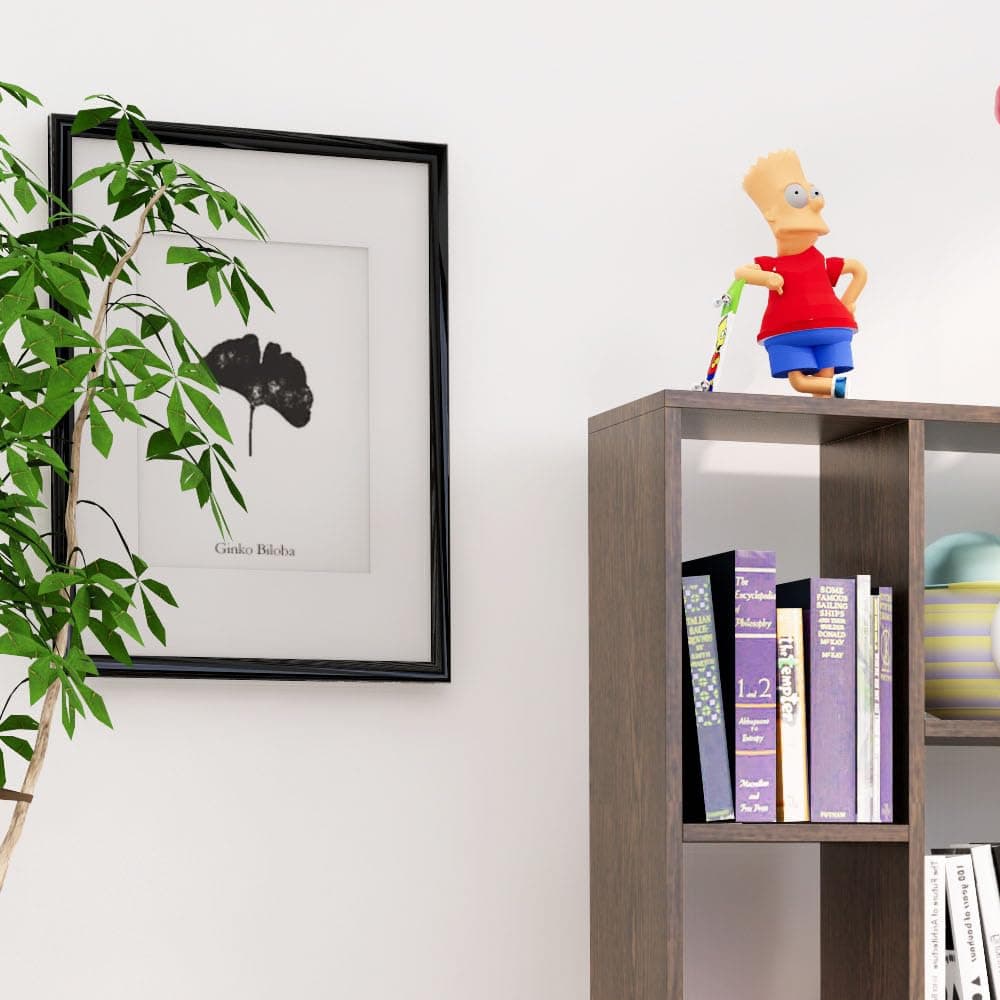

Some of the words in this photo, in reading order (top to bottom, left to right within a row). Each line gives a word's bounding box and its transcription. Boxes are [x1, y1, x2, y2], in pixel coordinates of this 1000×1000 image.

[214, 542, 253, 555] Ginko
[257, 543, 296, 557] Biloba
[738, 678, 744, 698] 1
[758, 678, 772, 698] 2
